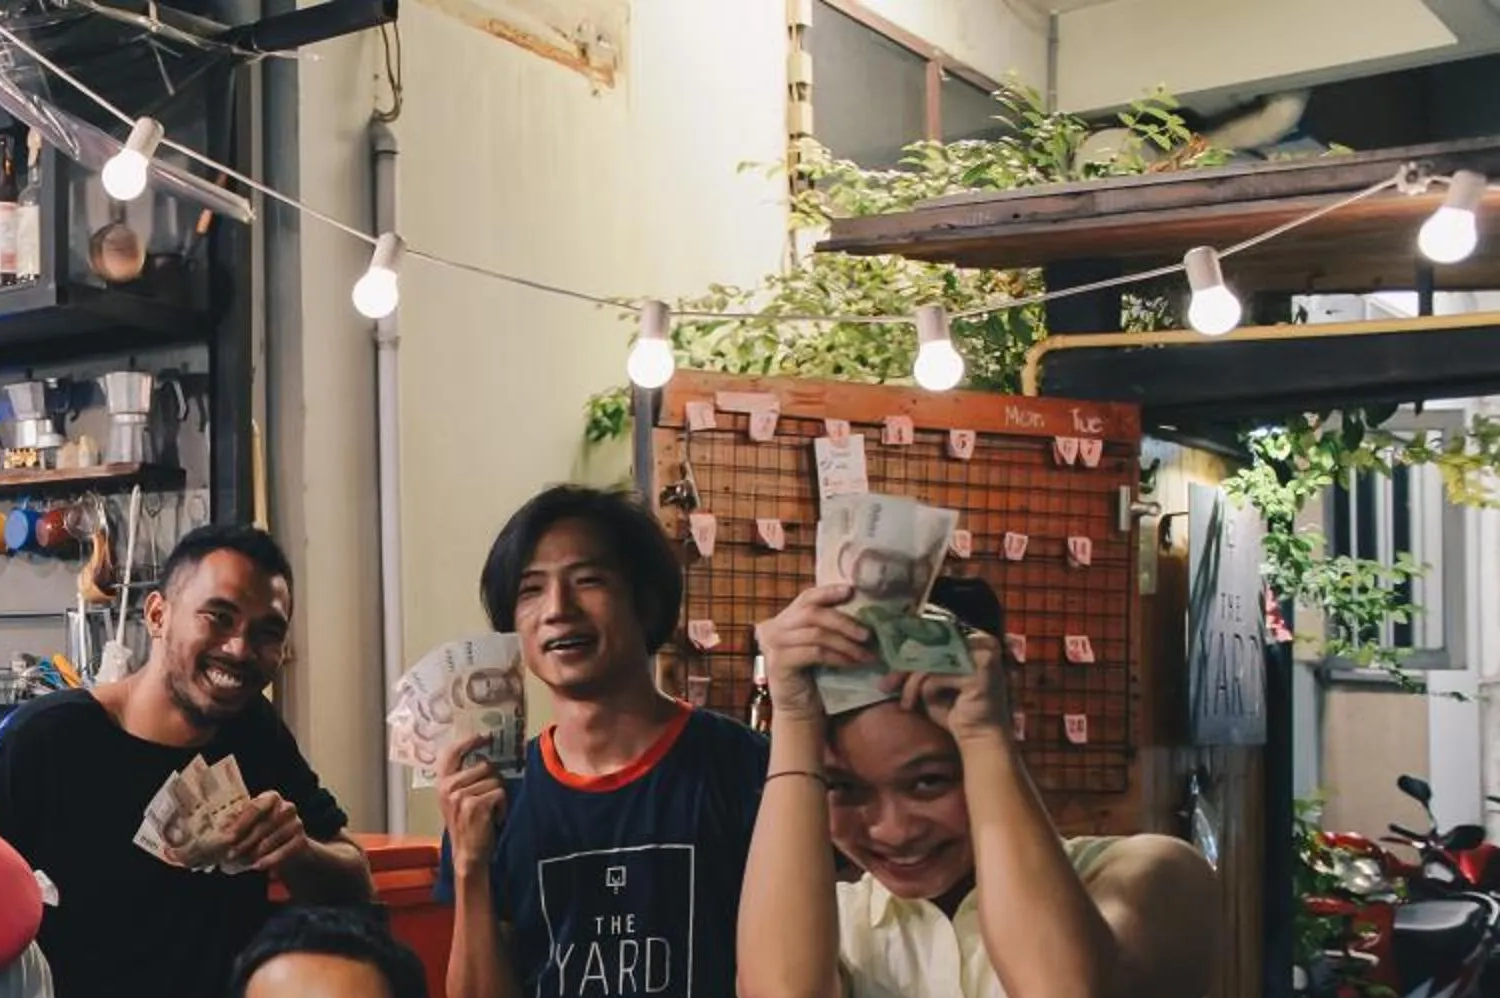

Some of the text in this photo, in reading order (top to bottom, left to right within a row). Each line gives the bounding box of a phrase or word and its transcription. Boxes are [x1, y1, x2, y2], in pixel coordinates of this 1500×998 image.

[1069, 407, 1103, 433] Tue
[1220, 592, 1242, 623] THE
[595, 913, 636, 935] THE
[555, 936, 671, 997] YARD
